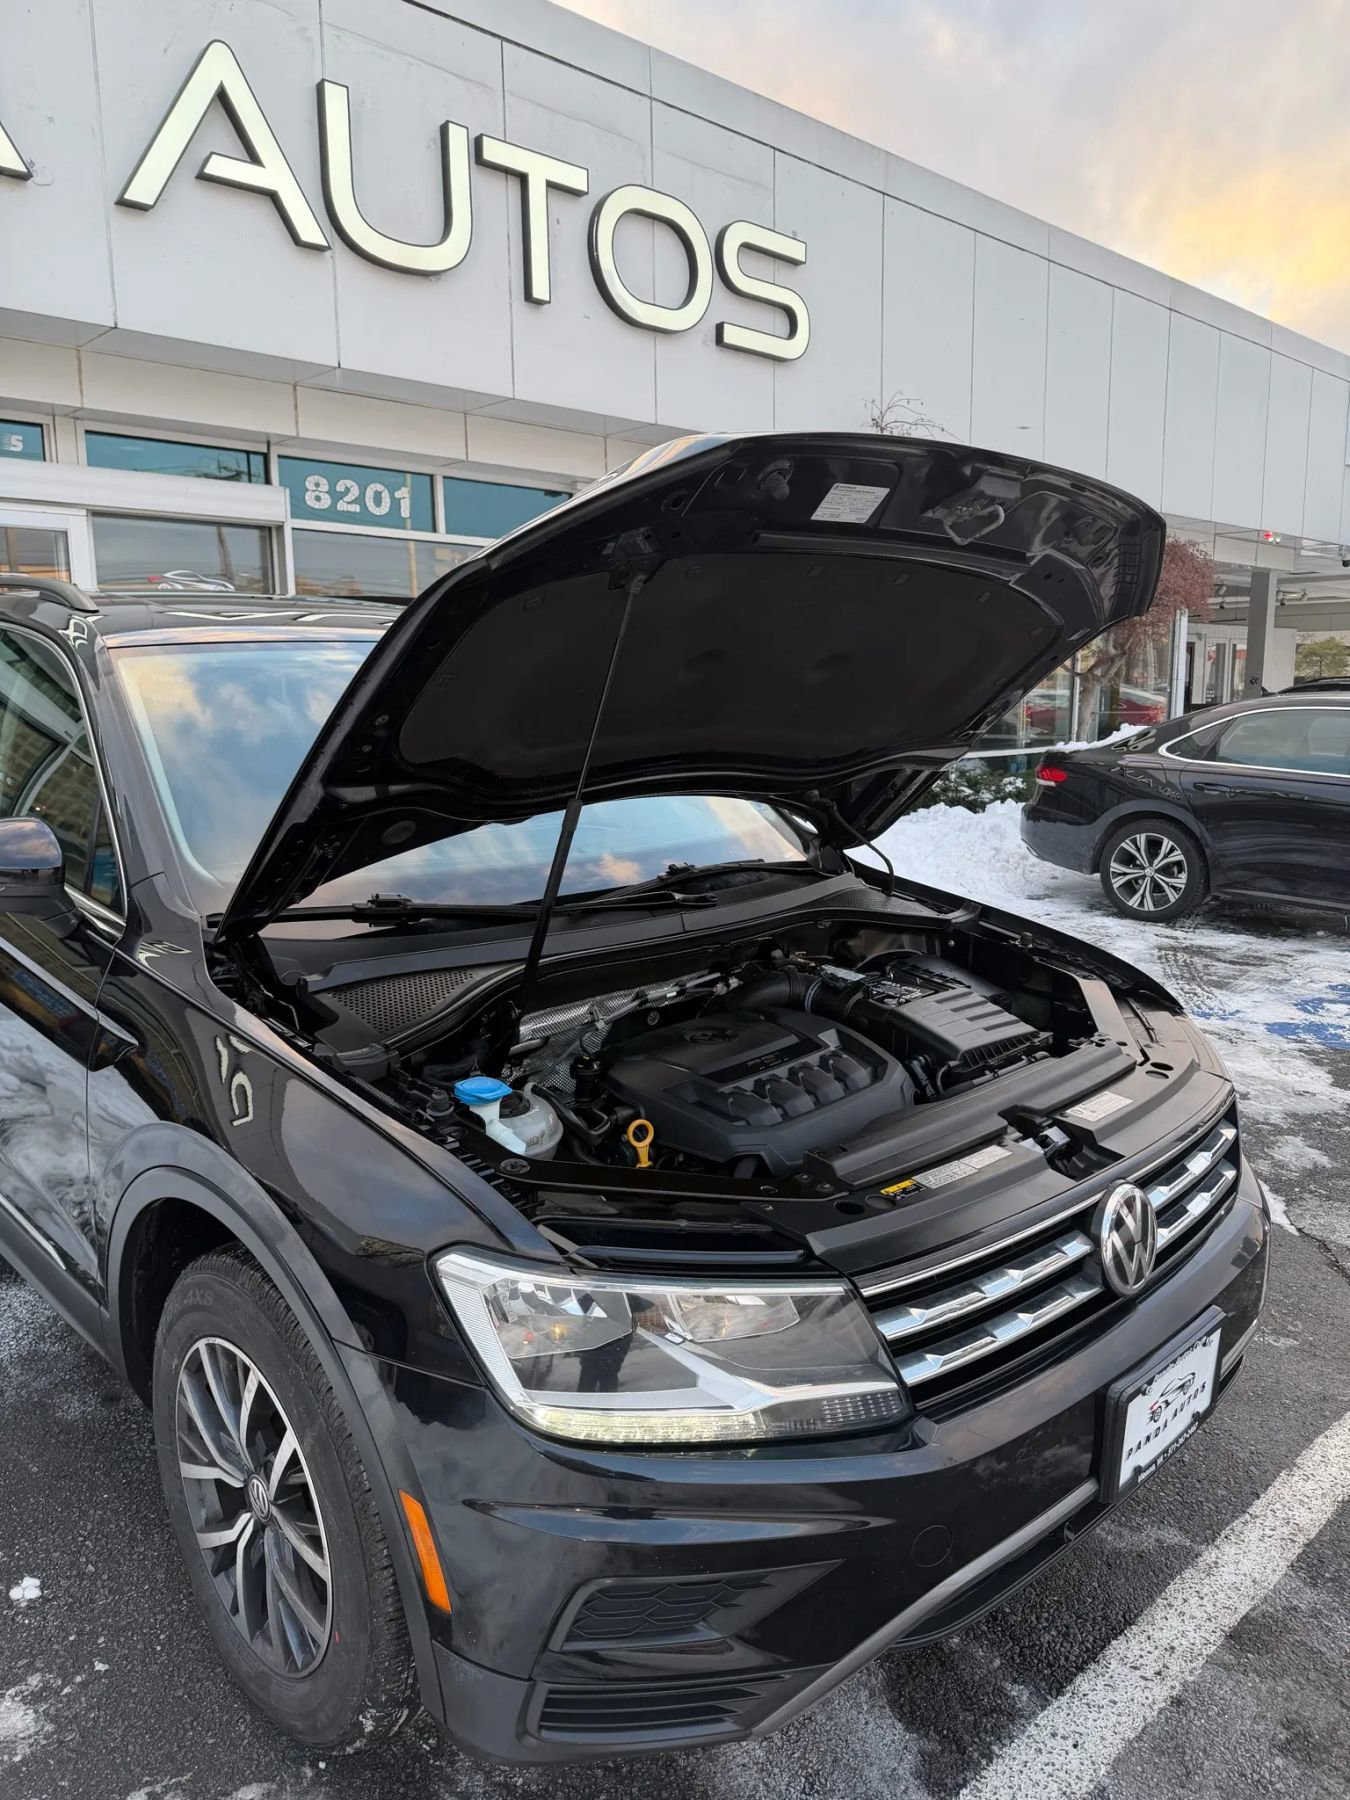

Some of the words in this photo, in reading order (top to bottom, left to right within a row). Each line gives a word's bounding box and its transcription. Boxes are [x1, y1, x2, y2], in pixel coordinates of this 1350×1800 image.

[116, 39, 809, 361] AUTOS
[305, 474, 410, 518] 8201
[1125, 1419, 1168, 1461] PANDA
[1171, 1381, 1206, 1420] AUTOS
